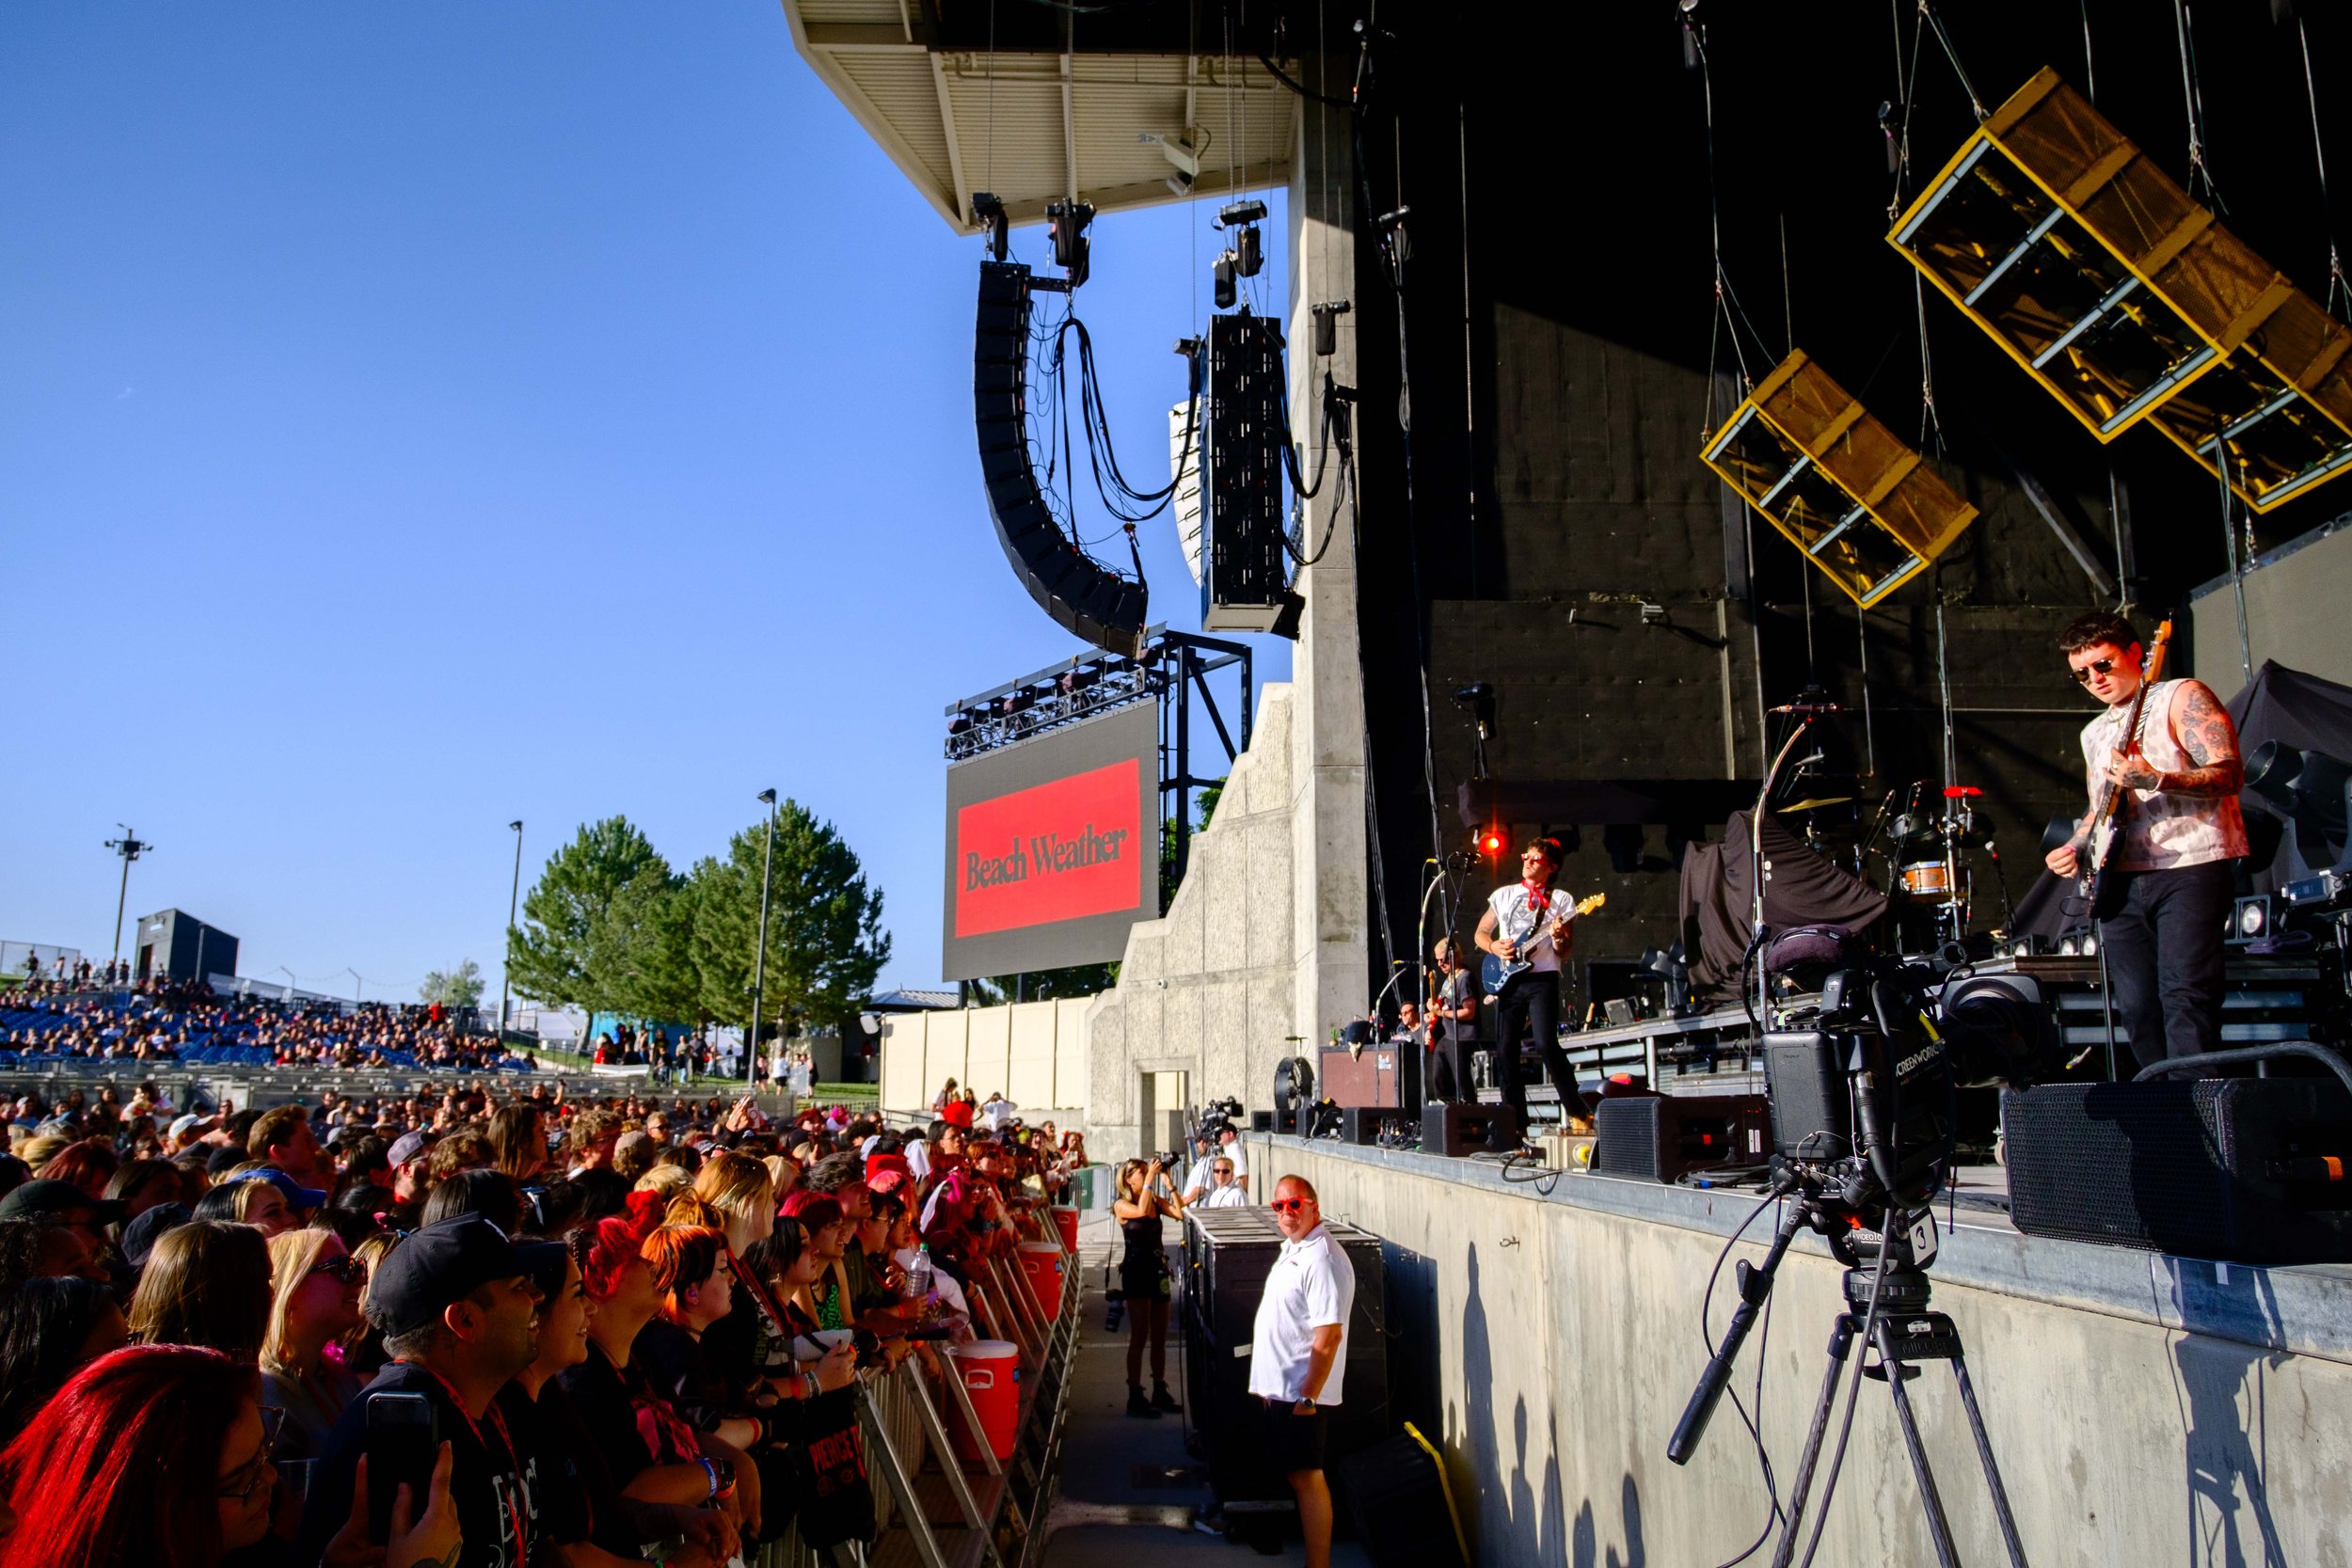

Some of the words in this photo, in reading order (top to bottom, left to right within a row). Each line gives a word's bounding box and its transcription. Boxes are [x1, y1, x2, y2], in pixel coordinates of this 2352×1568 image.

[965, 837, 1027, 892] Beach
[1030, 823, 1128, 876] Weather
[1895, 1043, 1941, 1078] CREENWORK
[1915, 1226, 1926, 1249] 3
